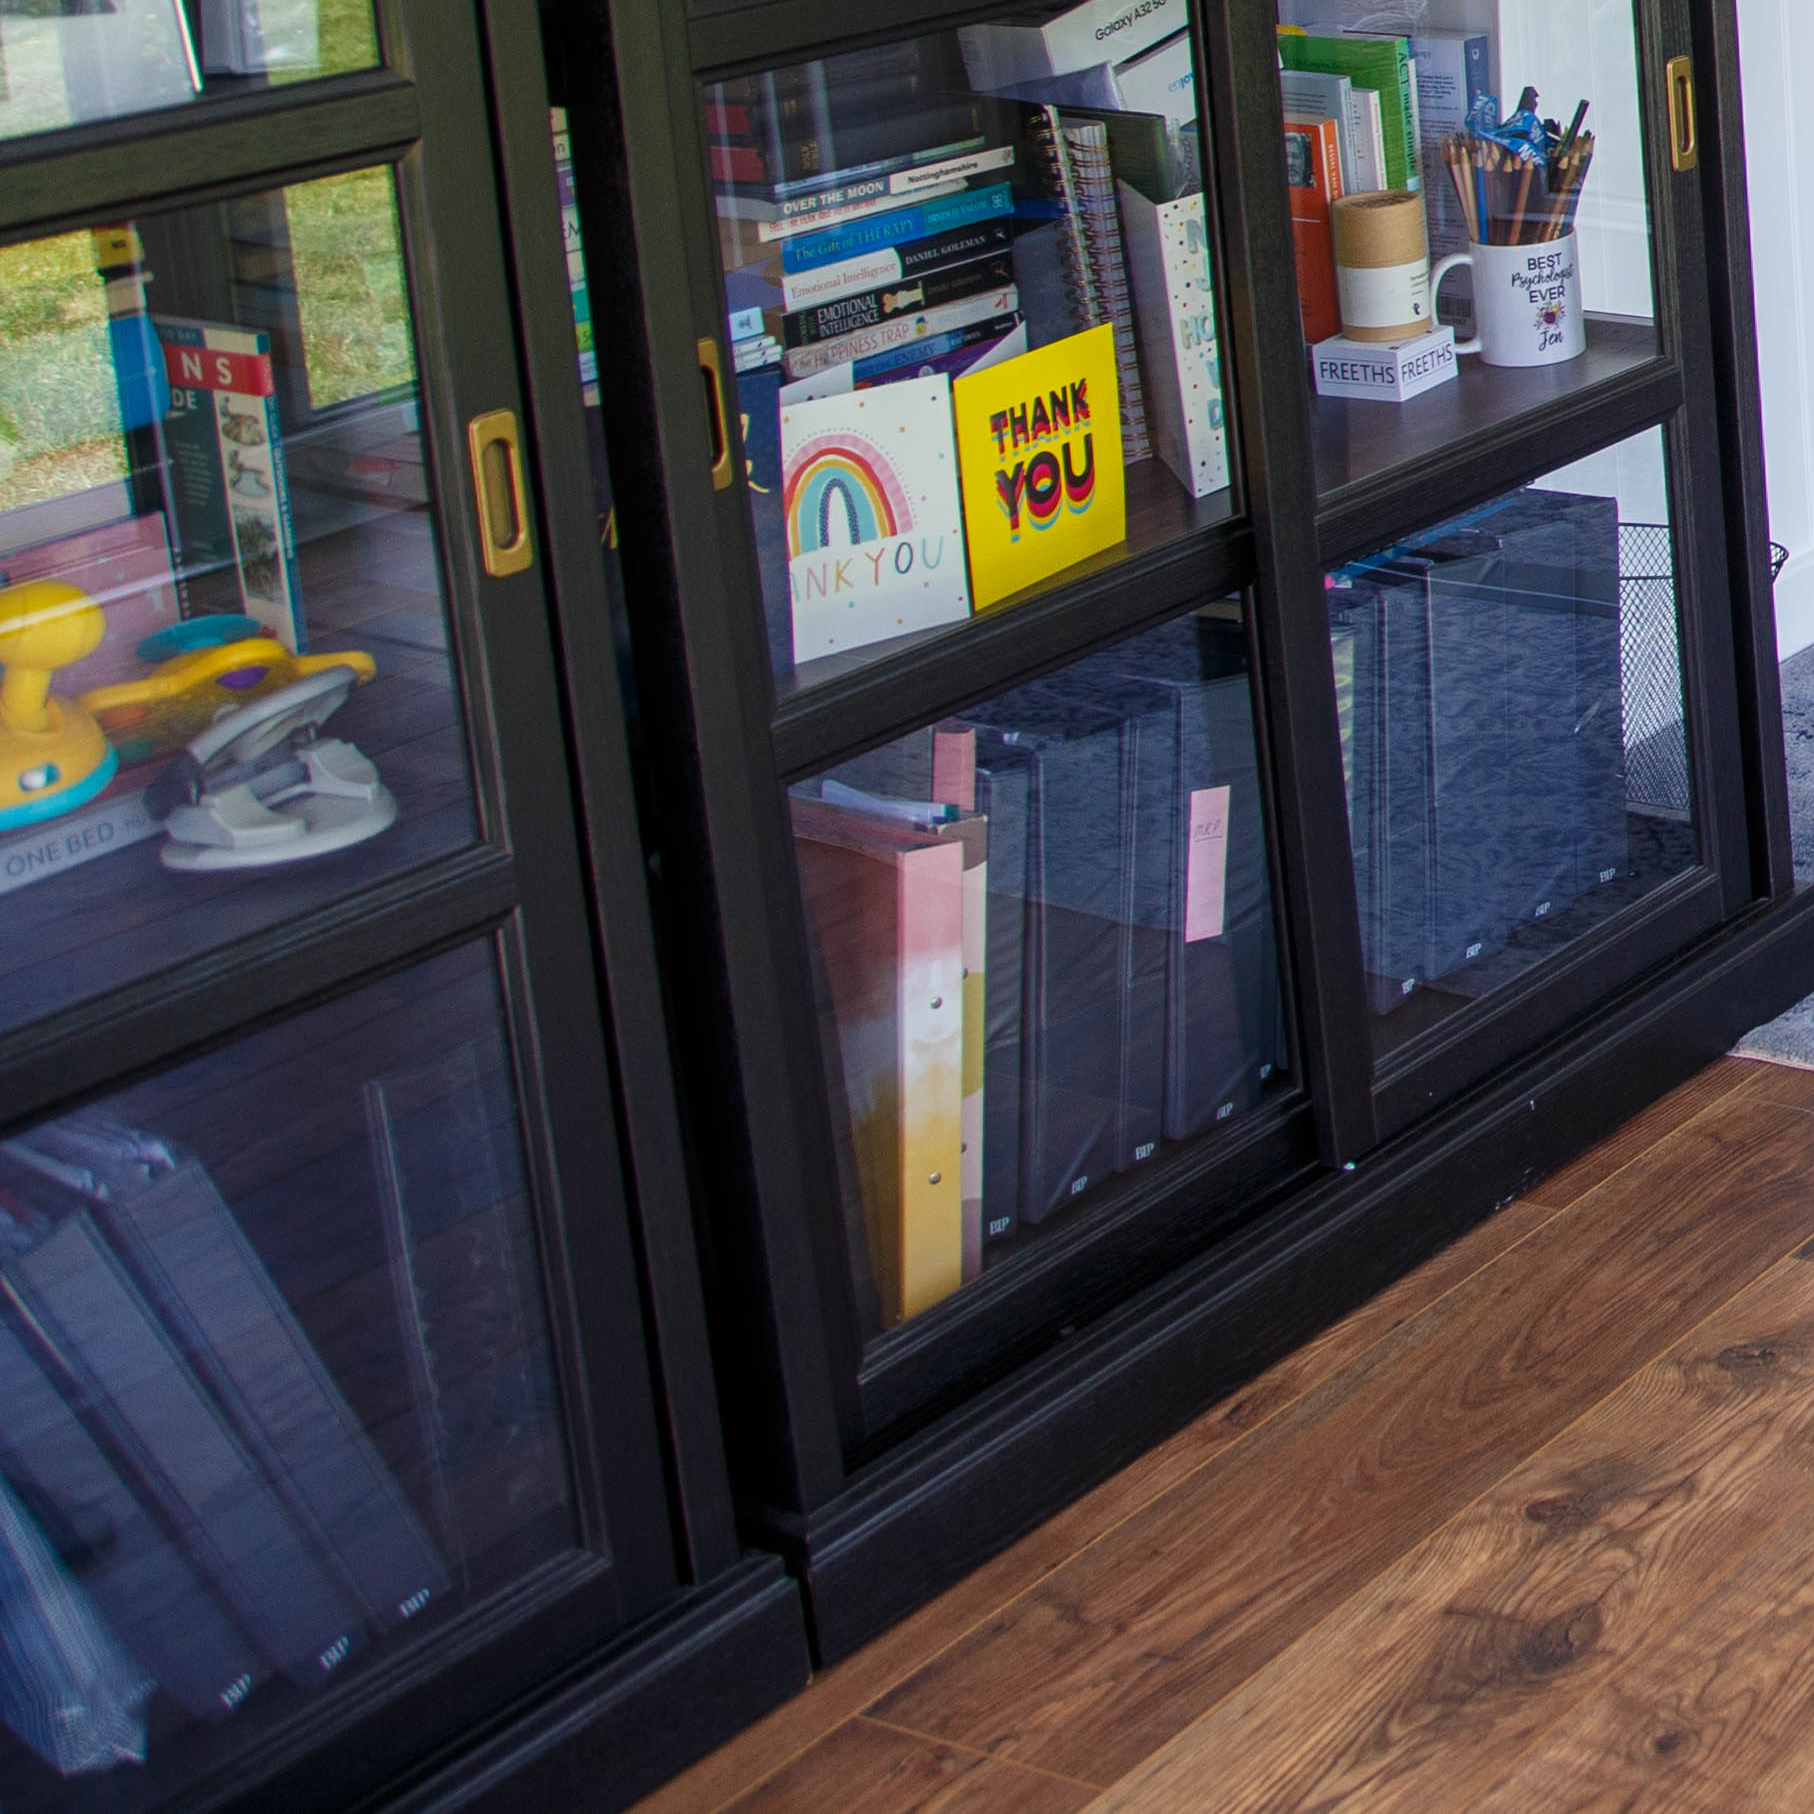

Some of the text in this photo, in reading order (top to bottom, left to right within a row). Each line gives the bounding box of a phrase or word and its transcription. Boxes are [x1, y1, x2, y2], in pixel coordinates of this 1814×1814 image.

[1095, 12, 1134, 41] Galaxy
[1134, 1, 1152, 21] A32
[783, 197, 817, 215] OVER
[819, 191, 844, 208] THE
[846, 180, 884, 201] MOON
[855, 217, 914, 245] THERAPY
[791, 236, 986, 299] Emotional Intelligence DANIEL GOLEMAN
[1527, 252, 1562, 271] BEST
[817, 294, 878, 325] EMOTIONAL
[1529, 285, 1566, 304] EVER
[819, 309, 881, 339] INTELLIGENCE
[879, 323, 909, 345] TRAP
[1538, 330, 1564, 352] Jen
[1320, 360, 1396, 384] FREETHS
[1401, 343, 1453, 383] FREETHS
[989, 377, 1091, 458] THANK
[994, 433, 1096, 538] YOU
[865, 535, 943, 587] YOU
[6, 822, 115, 876] ONE BED
